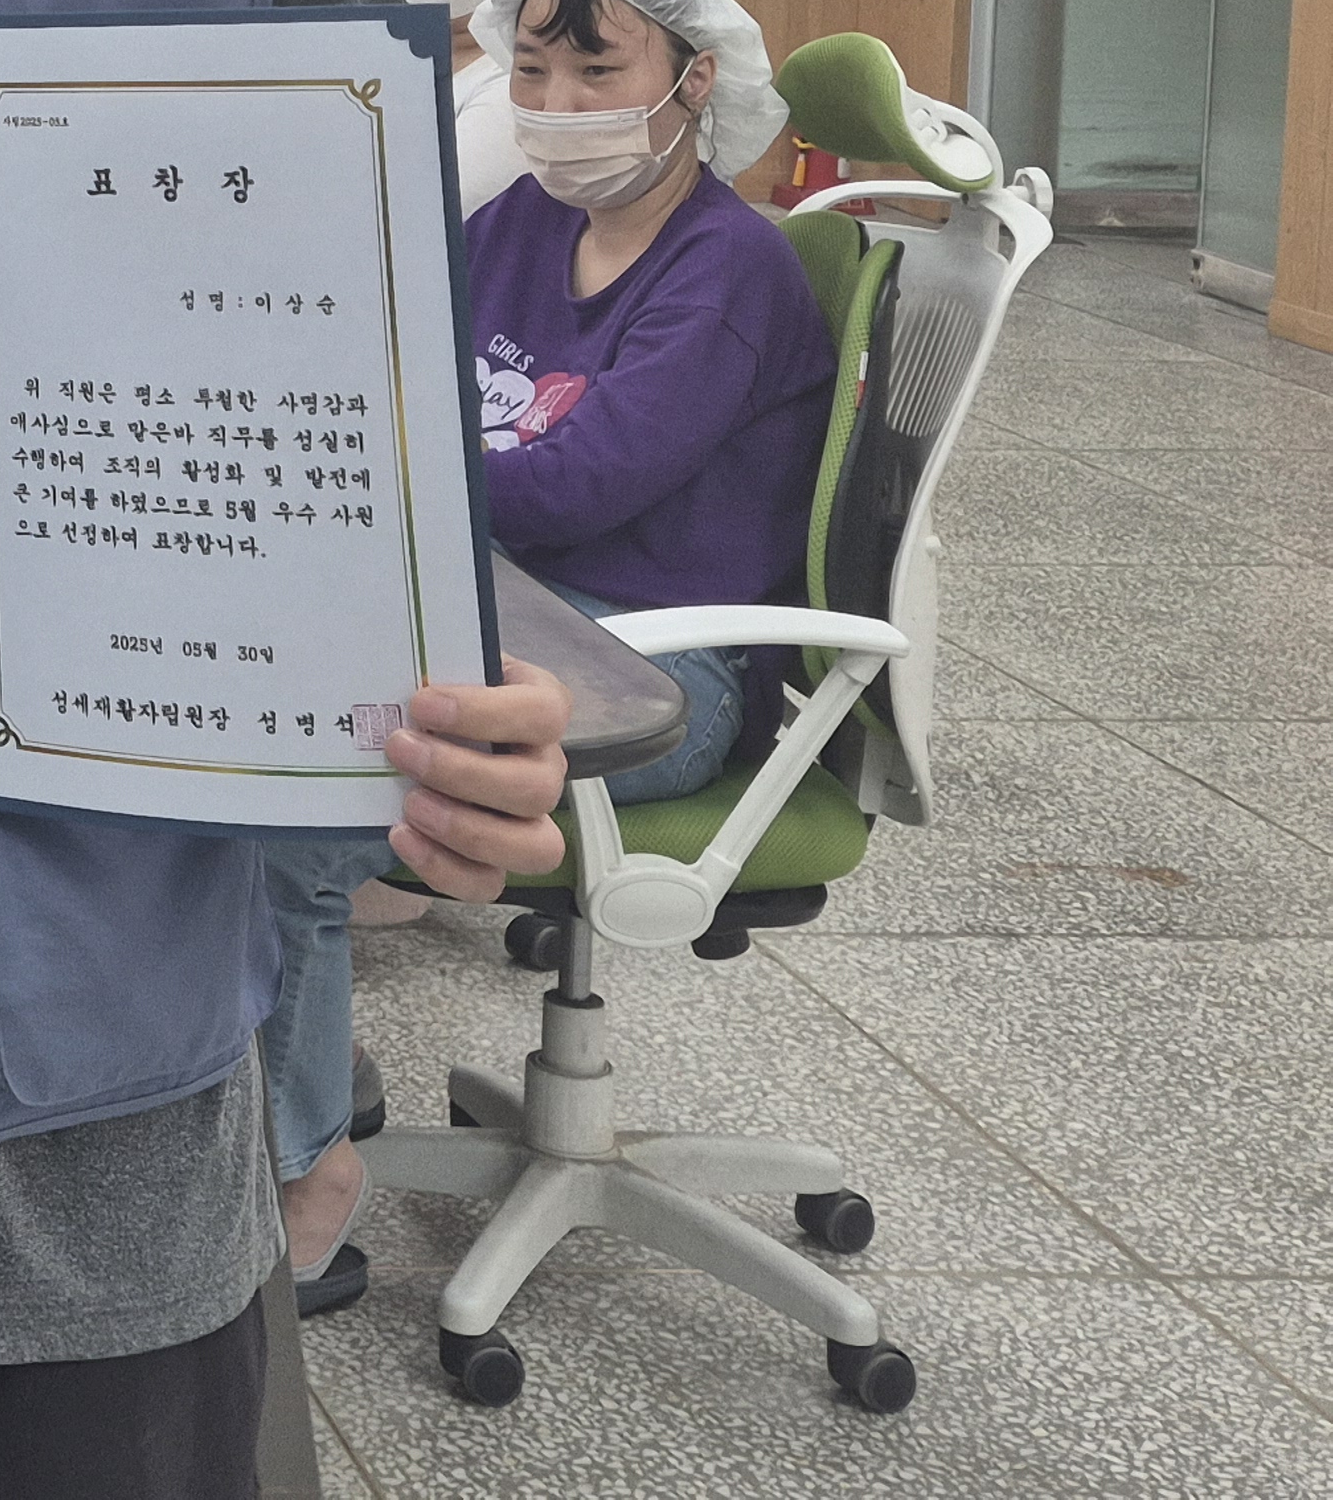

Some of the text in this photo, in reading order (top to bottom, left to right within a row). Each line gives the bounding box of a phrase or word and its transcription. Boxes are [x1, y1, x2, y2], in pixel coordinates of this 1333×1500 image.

[488, 333, 534, 373] GIRLS
[24, 376, 369, 418] 위 직원은 평소 투철한 사명감과
[10, 411, 115, 438] 애사심으로
[207, 424, 279, 451] 직무를
[292, 428, 364, 455] 성실히
[11, 446, 371, 492] 수행하여 조직의 활성화 및 발전에
[12, 482, 374, 528] 큰 기여를 하였으므로 5월 우수 사원
[14, 519, 267, 560] 으로 선정하여 표창합니다.
[110, 633, 274, 664] 2025년 05월 30일
[51, 689, 231, 732] 성세재활자립원장
